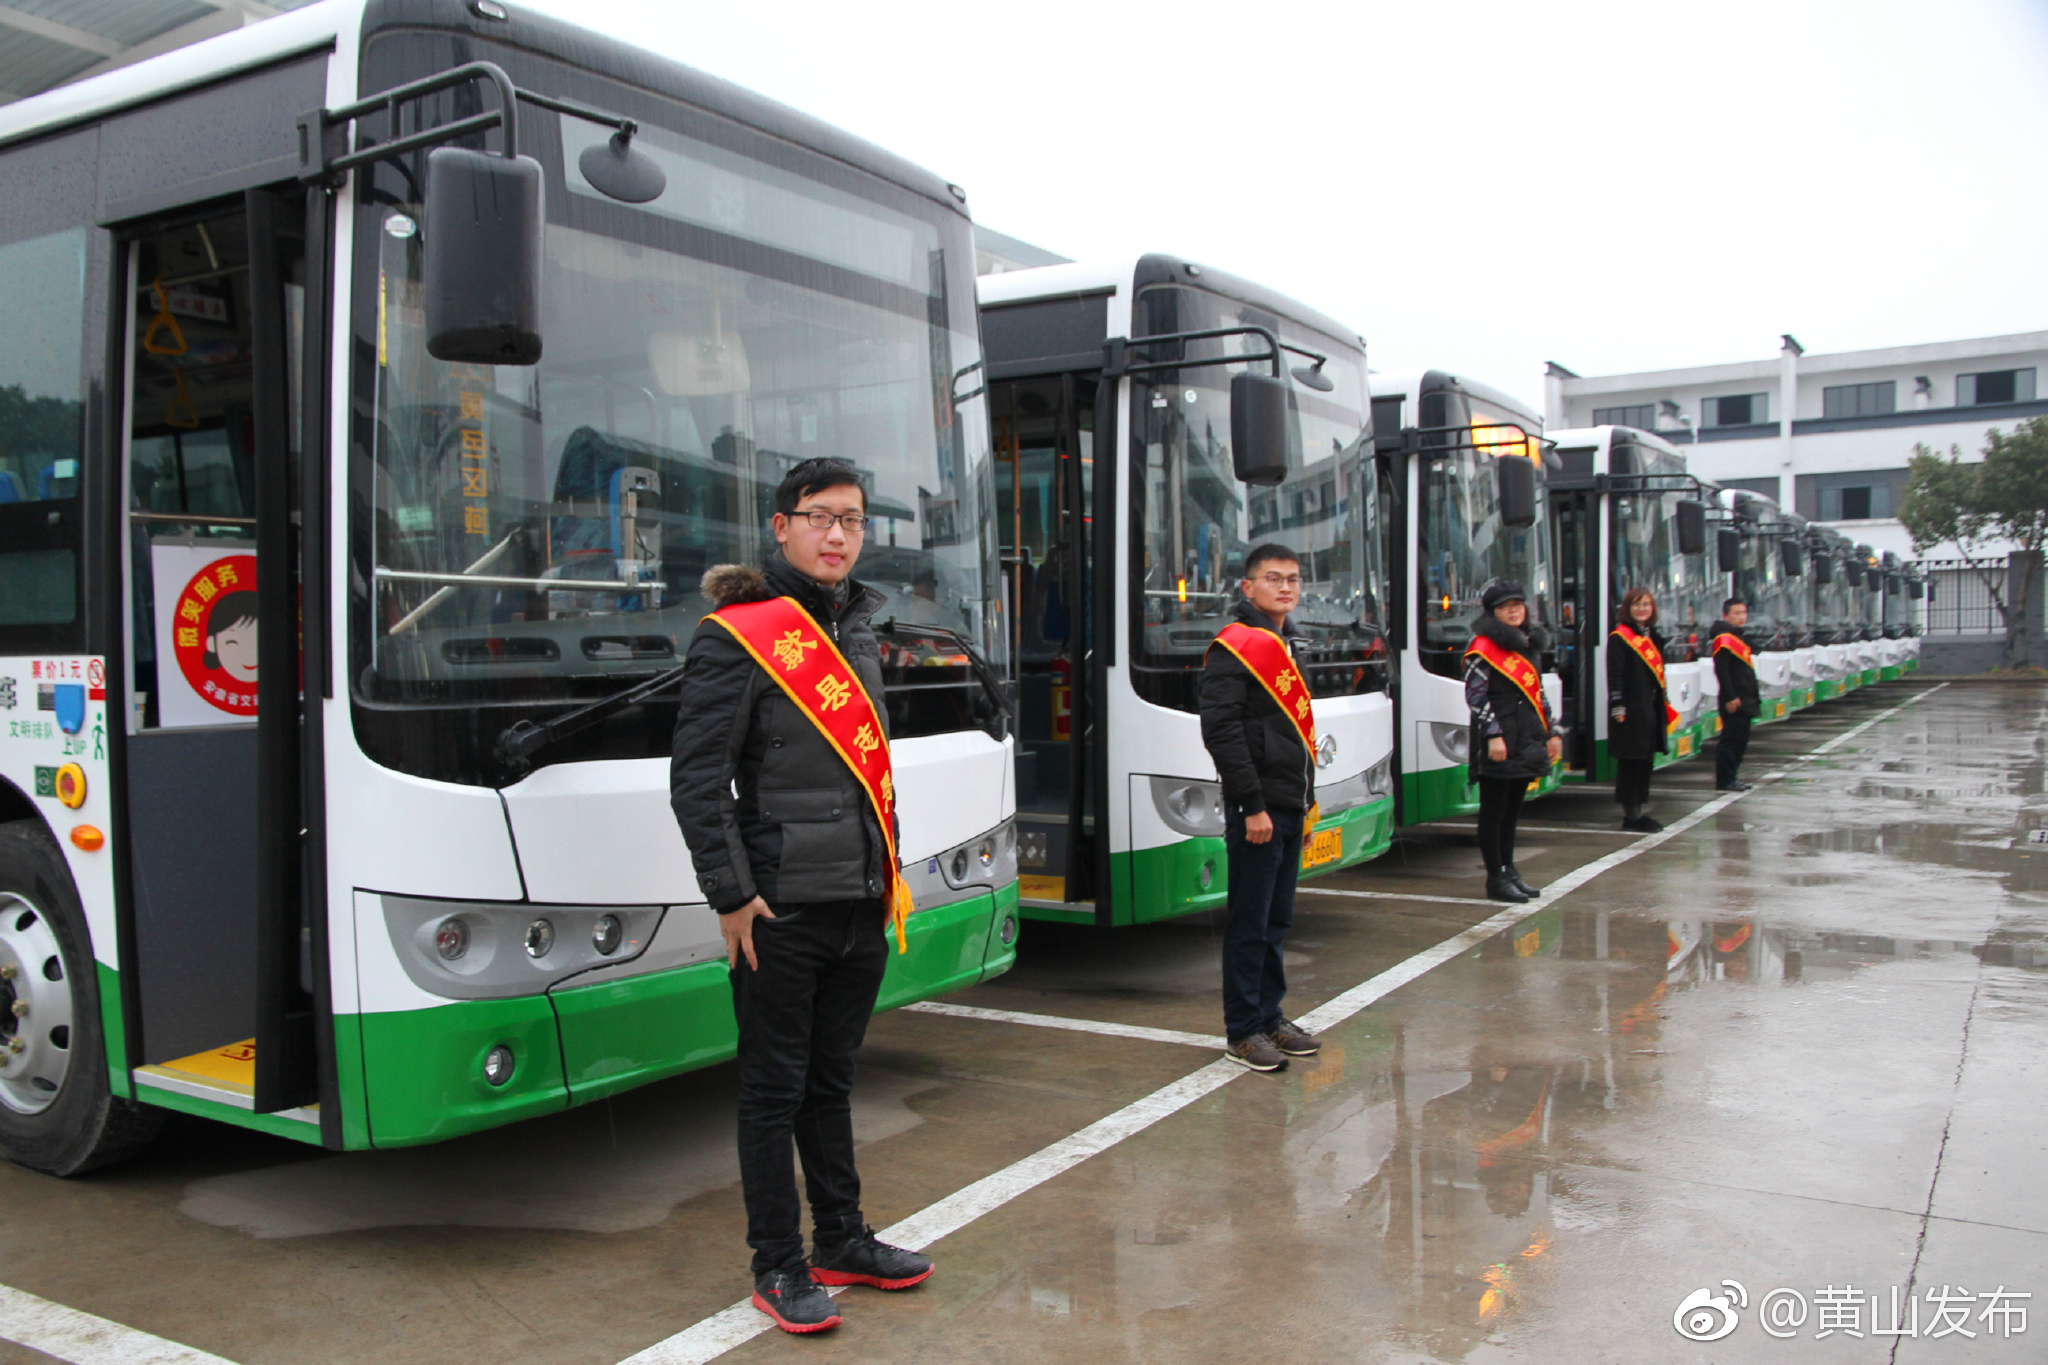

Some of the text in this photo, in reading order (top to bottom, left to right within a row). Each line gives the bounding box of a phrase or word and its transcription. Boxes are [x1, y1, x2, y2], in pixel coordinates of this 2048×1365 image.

[178, 563, 238, 648] 微笑服务
[32, 660, 82, 679] 票价1元
